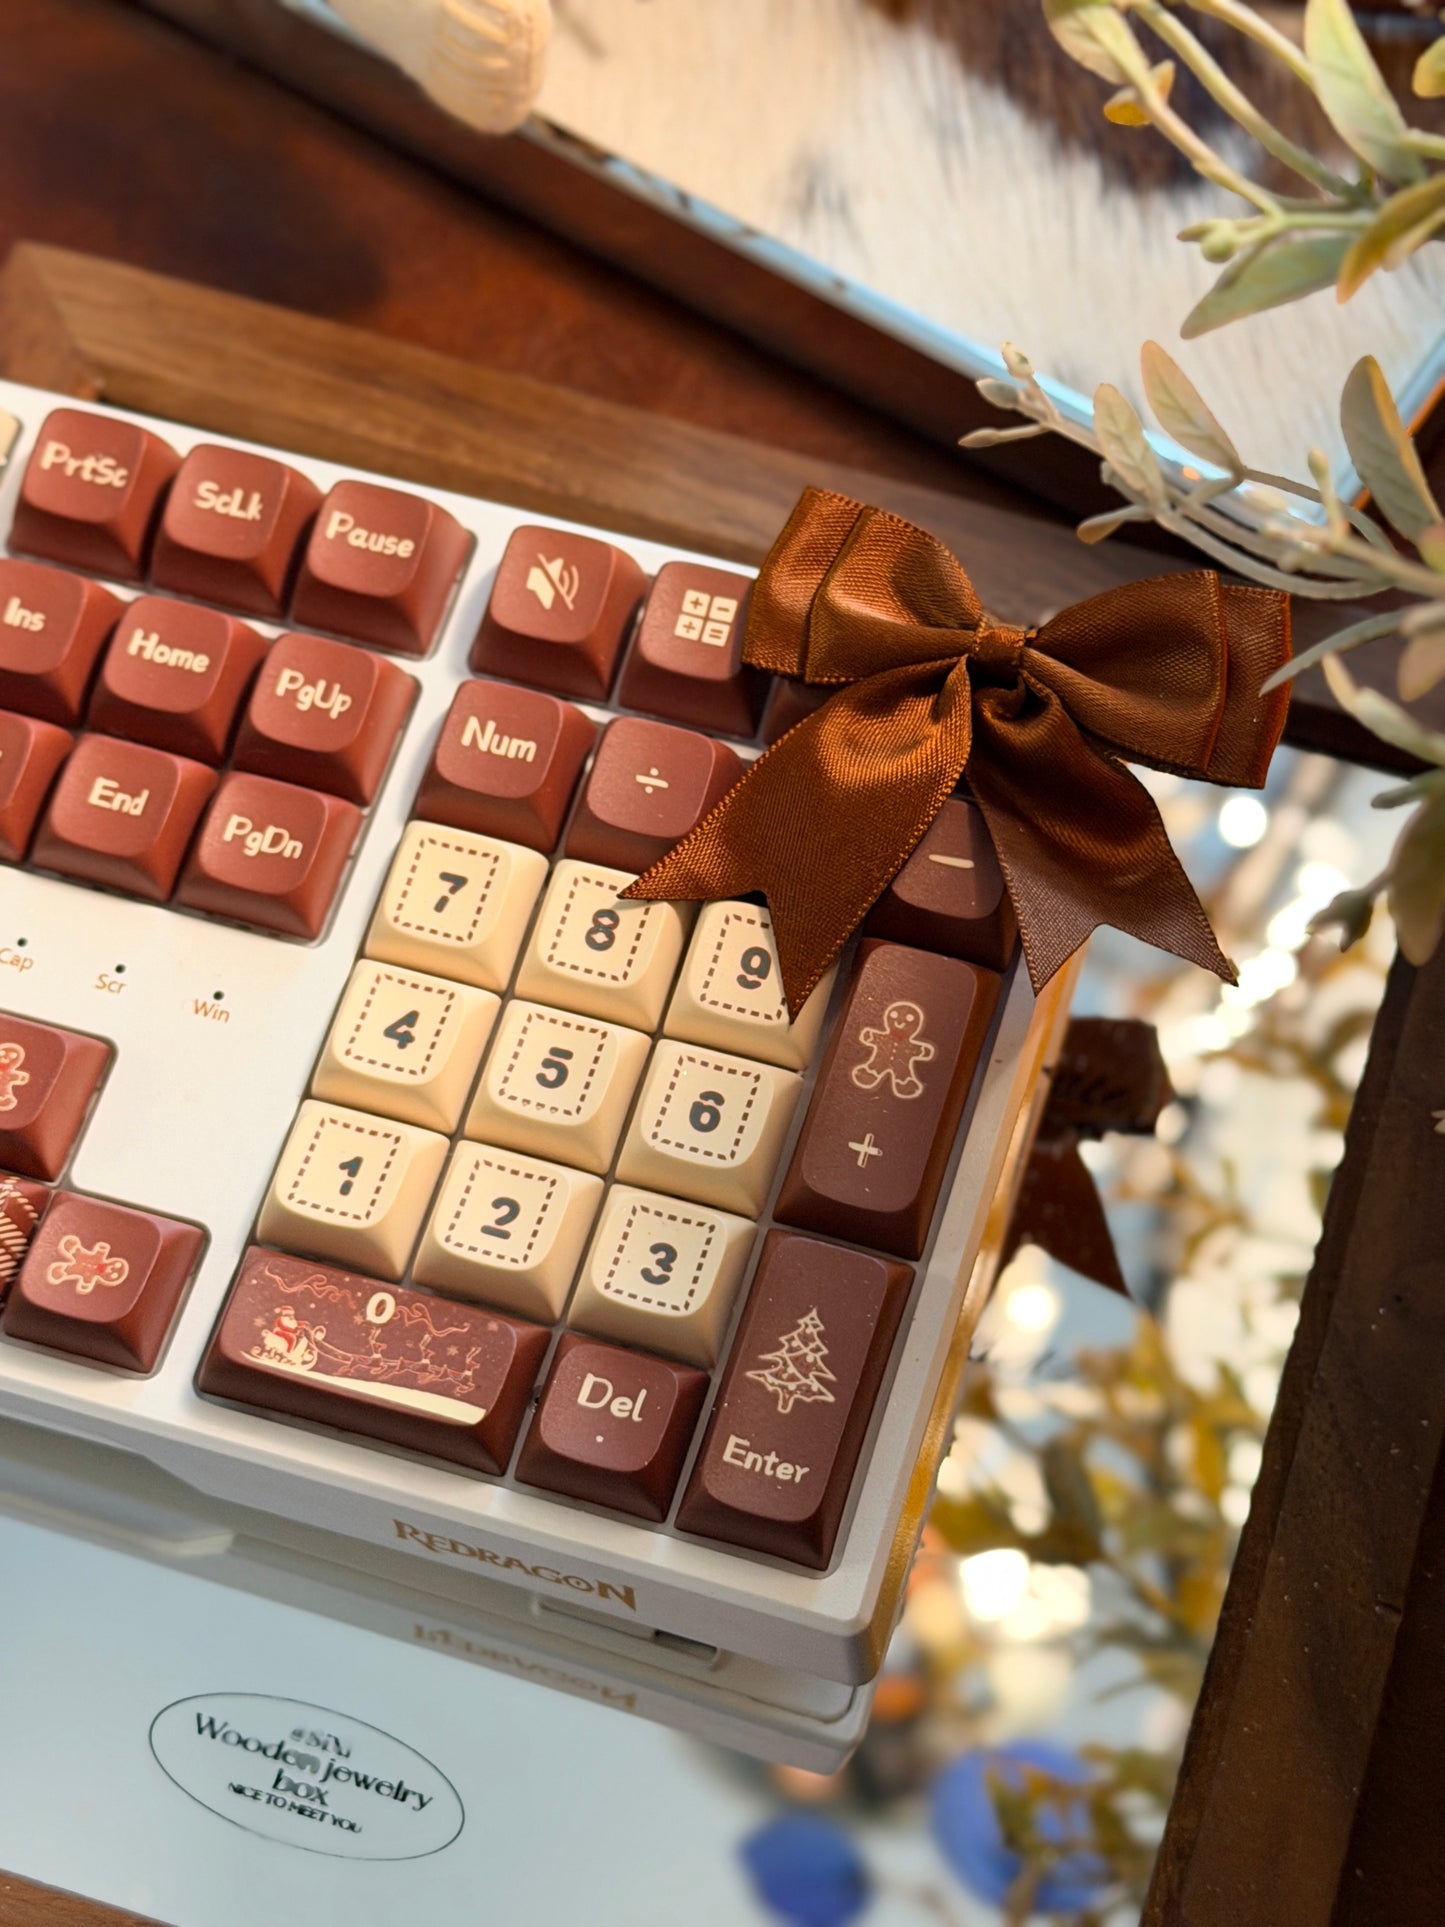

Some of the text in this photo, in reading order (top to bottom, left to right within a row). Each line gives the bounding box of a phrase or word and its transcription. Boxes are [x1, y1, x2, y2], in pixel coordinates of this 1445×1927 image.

[40, 440, 128, 488] PrtSc
[194, 481, 263, 522] ScLk
[325, 511, 415, 558] Pause
[4, 596, 46, 632] Ins
[128, 629, 210, 673] Home
[276, 668, 352, 719] PgUp
[461, 715, 538, 763] Num
[88, 777, 149, 816] End
[223, 813, 304, 860] PgDn
[433, 871, 468, 913] 7
[584, 908, 621, 952] 8
[0, 946, 34, 972] Cap
[735, 945, 772, 990] 9
[95, 973, 127, 994] Scr
[192, 998, 231, 1023] Win
[383, 1010, 420, 1050] 4
[535, 1046, 574, 1090] 5
[688, 1090, 726, 1134] 6
[338, 1156, 364, 1197] 1
[480, 1196, 521, 1241] 2
[640, 1242, 678, 1286] 3
[365, 1291, 397, 1325] 0
[575, 1374, 648, 1423] Del
[722, 1434, 811, 1484] Enter
[393, 1519, 637, 1612] REDRAGON
[272, 1768, 328, 1806] box
[319, 1758, 433, 1811] jewelry
[266, 1792, 287, 1808] TO
[287, 1801, 330, 1822] MEET
[331, 1814, 362, 1833] YOU
